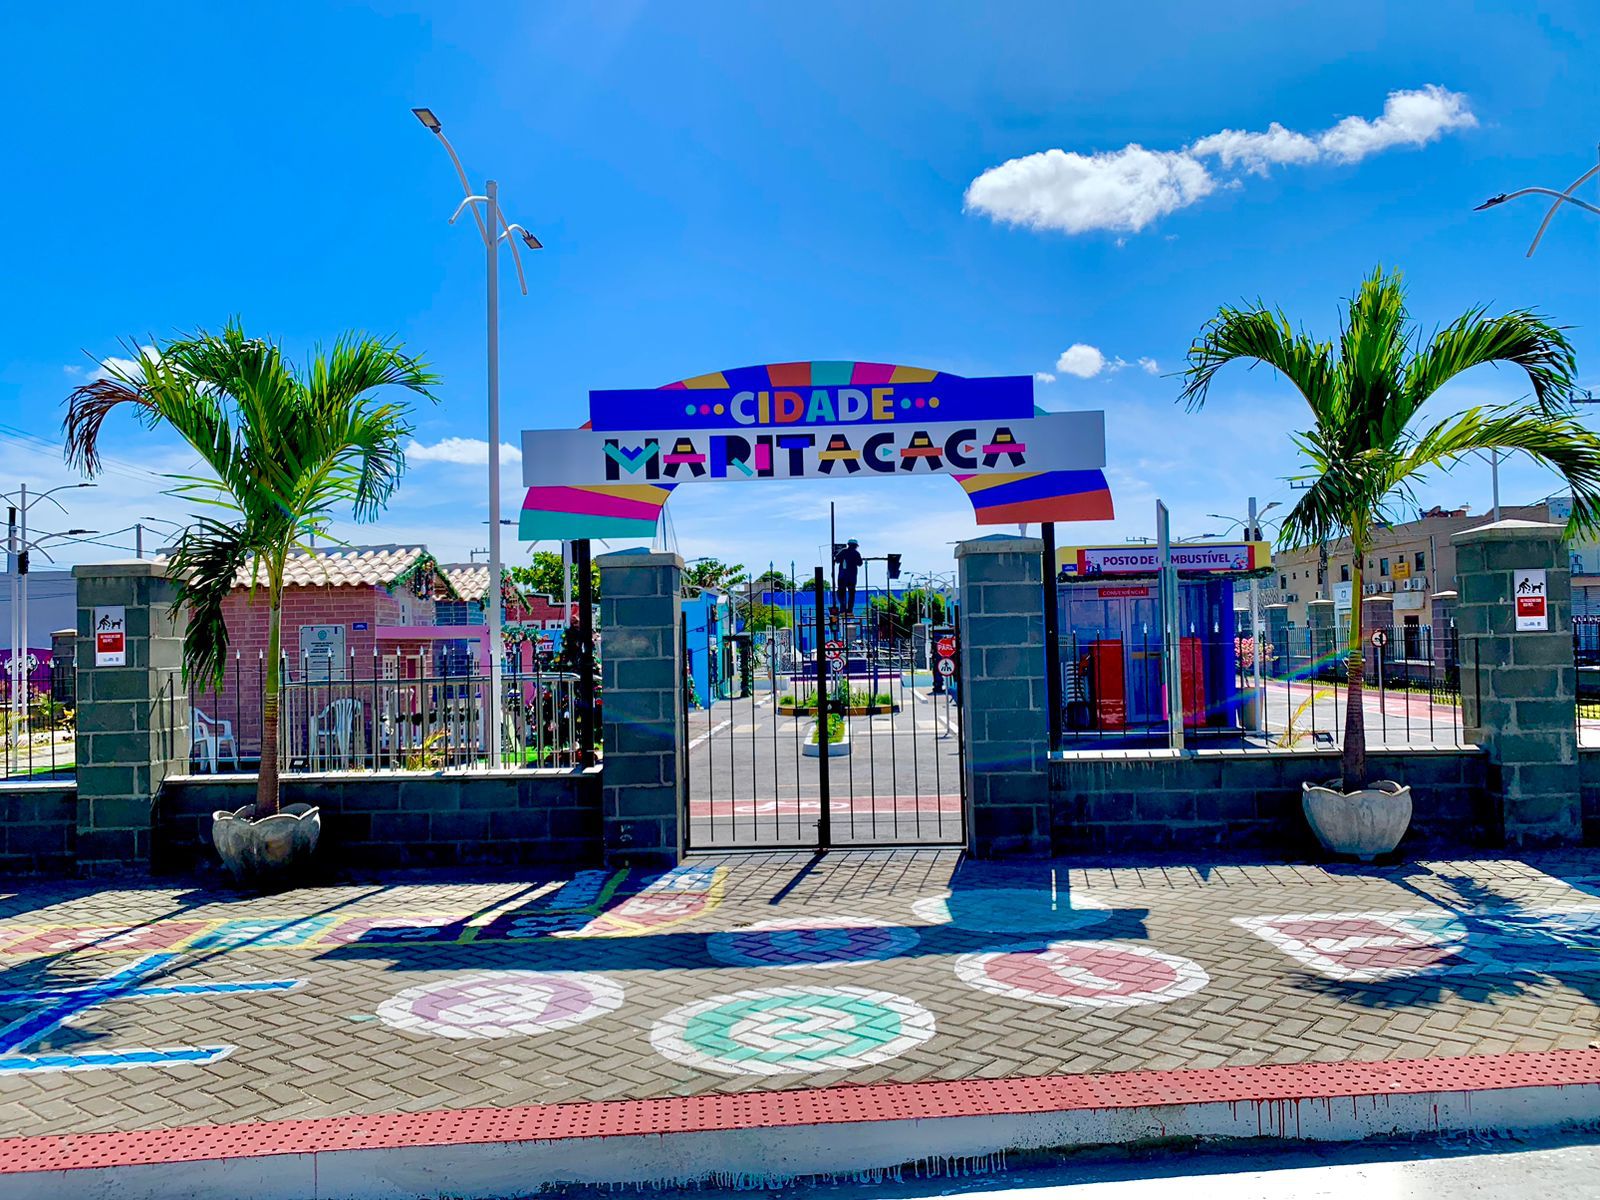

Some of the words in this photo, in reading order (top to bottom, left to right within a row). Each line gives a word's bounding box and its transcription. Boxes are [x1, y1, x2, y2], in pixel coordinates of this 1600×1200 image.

[730, 387, 894, 424] CIDADE
[602, 427, 1026, 480] MARITACACA
[1103, 556, 1140, 565] POSTO
[1140, 555, 1155, 565] DE
[1156, 550, 1230, 564] MBUSTÍVEL
